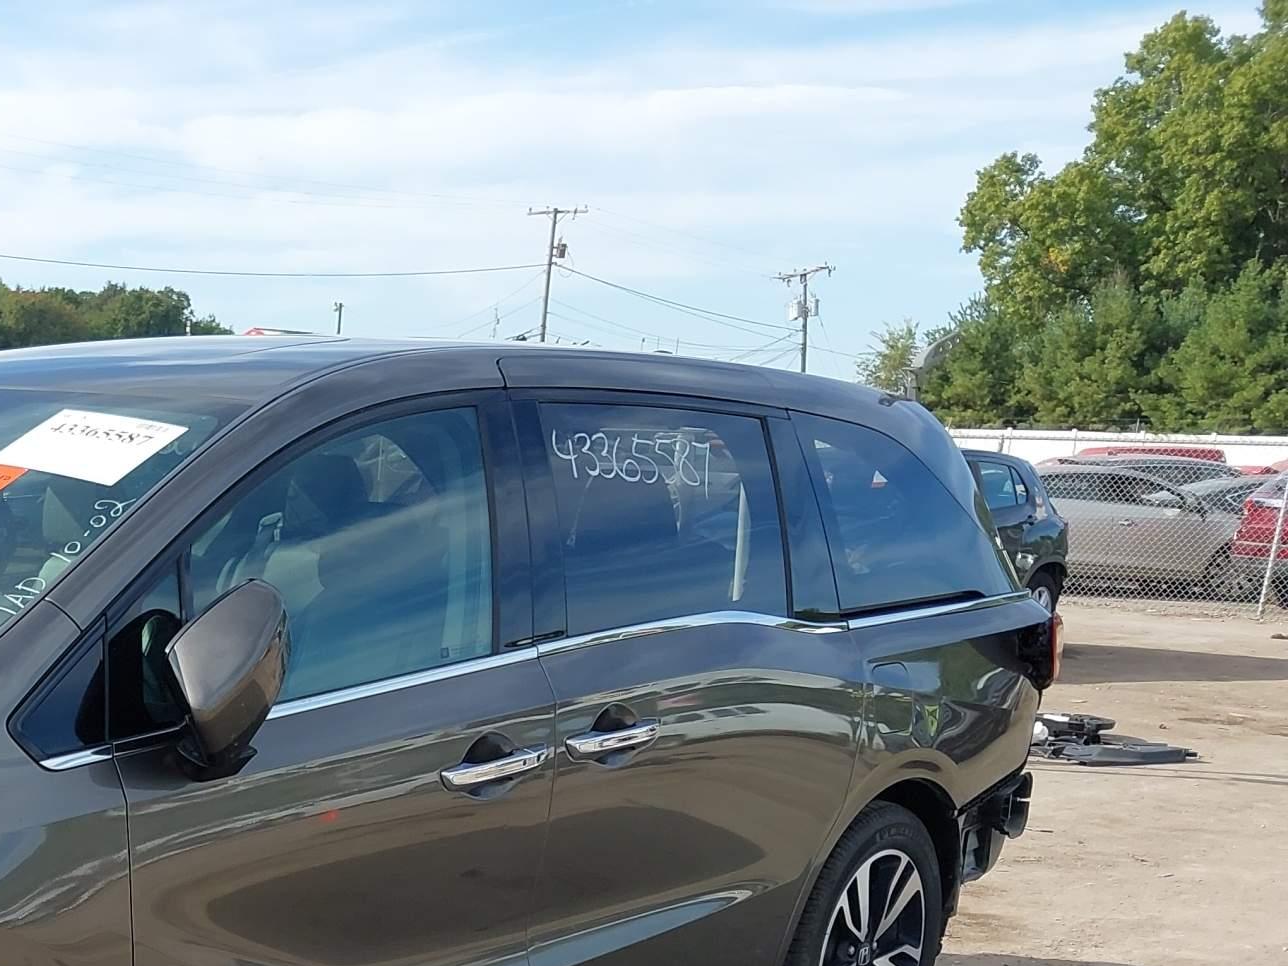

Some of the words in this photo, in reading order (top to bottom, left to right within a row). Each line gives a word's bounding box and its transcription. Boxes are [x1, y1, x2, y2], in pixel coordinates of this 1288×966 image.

[49, 422, 155, 447] 43365587
[551, 428, 711, 500] 43365587
[50, 498, 137, 563] 10-02
